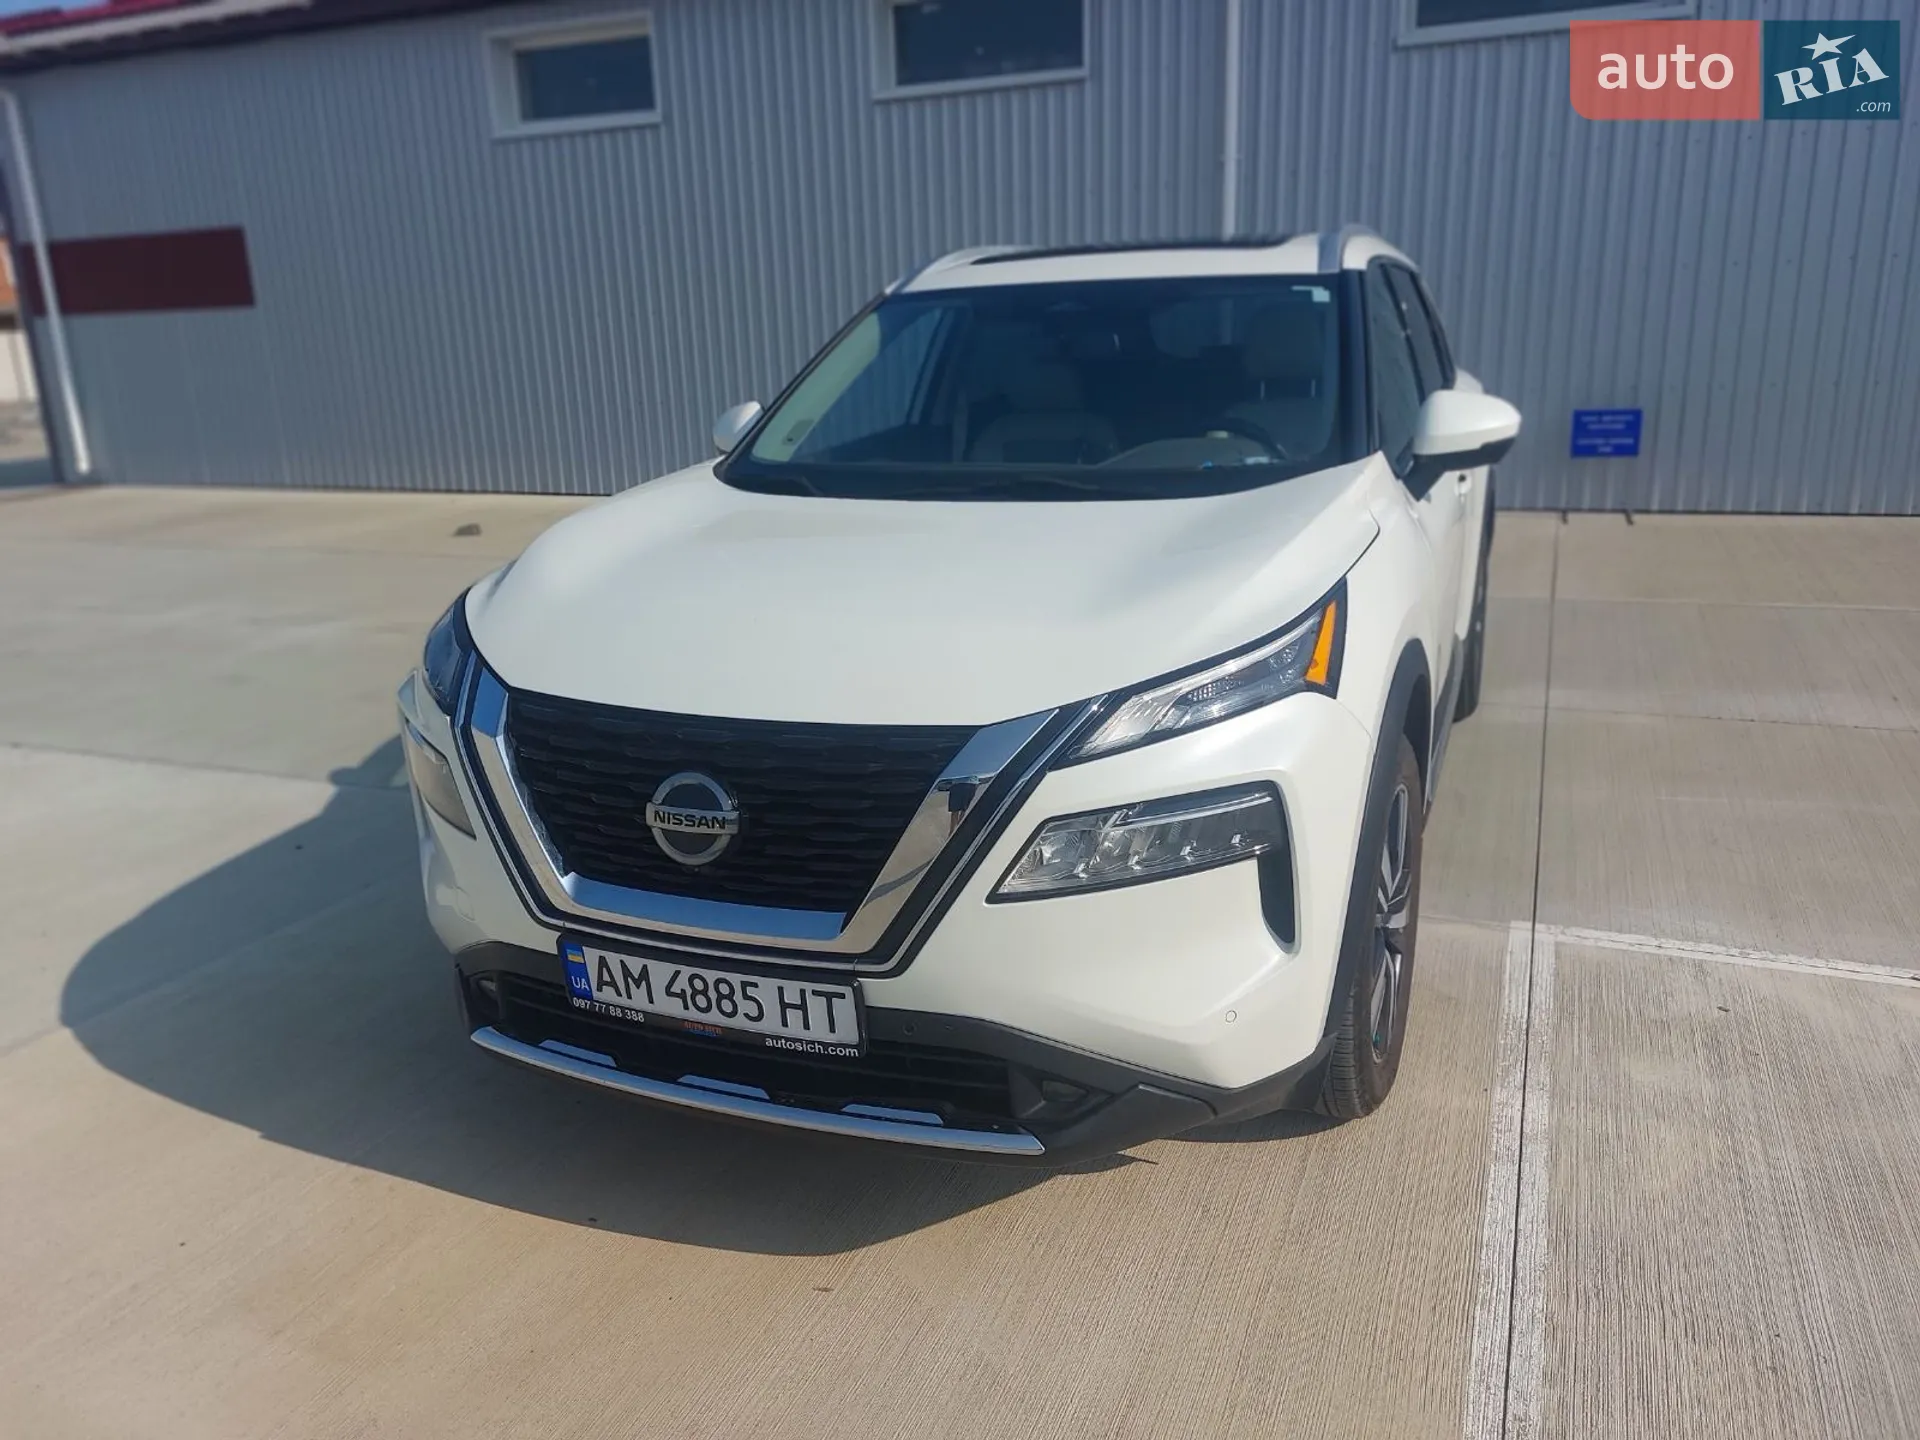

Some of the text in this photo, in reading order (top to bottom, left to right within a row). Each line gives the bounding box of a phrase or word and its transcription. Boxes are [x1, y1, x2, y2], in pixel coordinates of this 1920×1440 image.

[653, 810, 726, 830] NISSAN
[571, 975, 590, 991] UA
[595, 955, 846, 1034] AM 4885 HT
[572, 996, 645, 1023] 097 77 88 388
[765, 1036, 859, 1058] autosich.com
